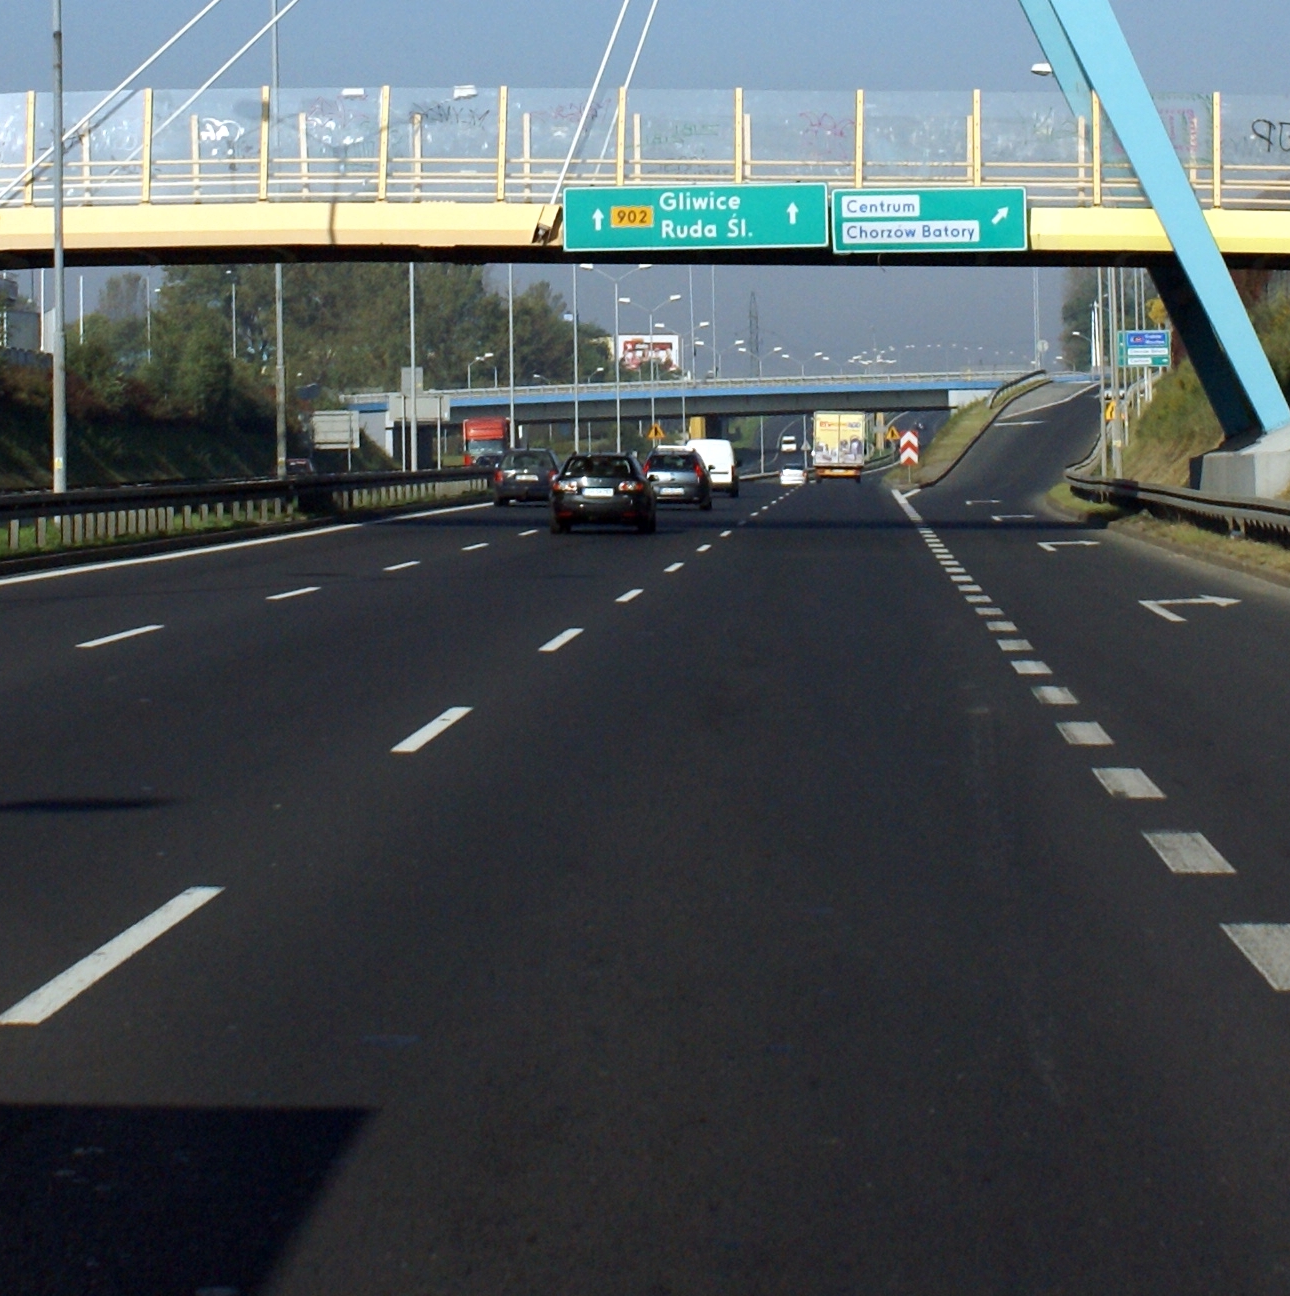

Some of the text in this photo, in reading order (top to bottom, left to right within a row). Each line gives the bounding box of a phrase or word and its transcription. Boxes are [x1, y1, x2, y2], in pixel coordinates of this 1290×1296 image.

[659, 191, 741, 211] Gliwice
[847, 199, 915, 213] Centrum
[617, 209, 647, 223] 902
[661, 213, 753, 238] Ruda Śl.
[847, 224, 975, 241] Chorzów Batory
